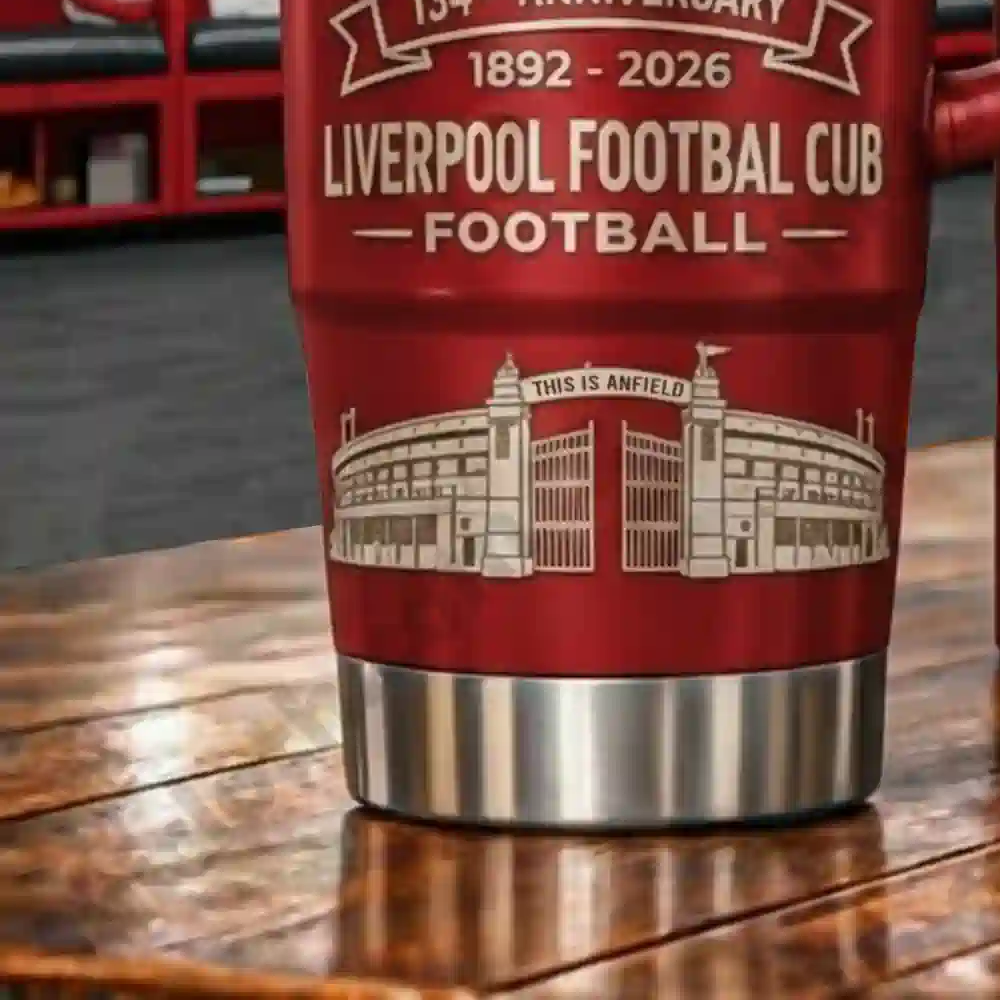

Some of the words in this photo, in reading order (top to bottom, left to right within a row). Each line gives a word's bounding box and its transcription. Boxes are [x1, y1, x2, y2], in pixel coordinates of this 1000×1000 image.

[468, 50, 573, 89] 1892
[617, 50, 732, 89] 2026
[324, 120, 555, 197] LIVERPOOL
[568, 119, 796, 196] FOOTBAL
[806, 122, 883, 196] CUB
[424, 211, 768, 253] FOOTBALL
[532, 376, 575, 397] THIS
[582, 375, 600, 391] IS
[607, 374, 684, 397] ANFIELD
